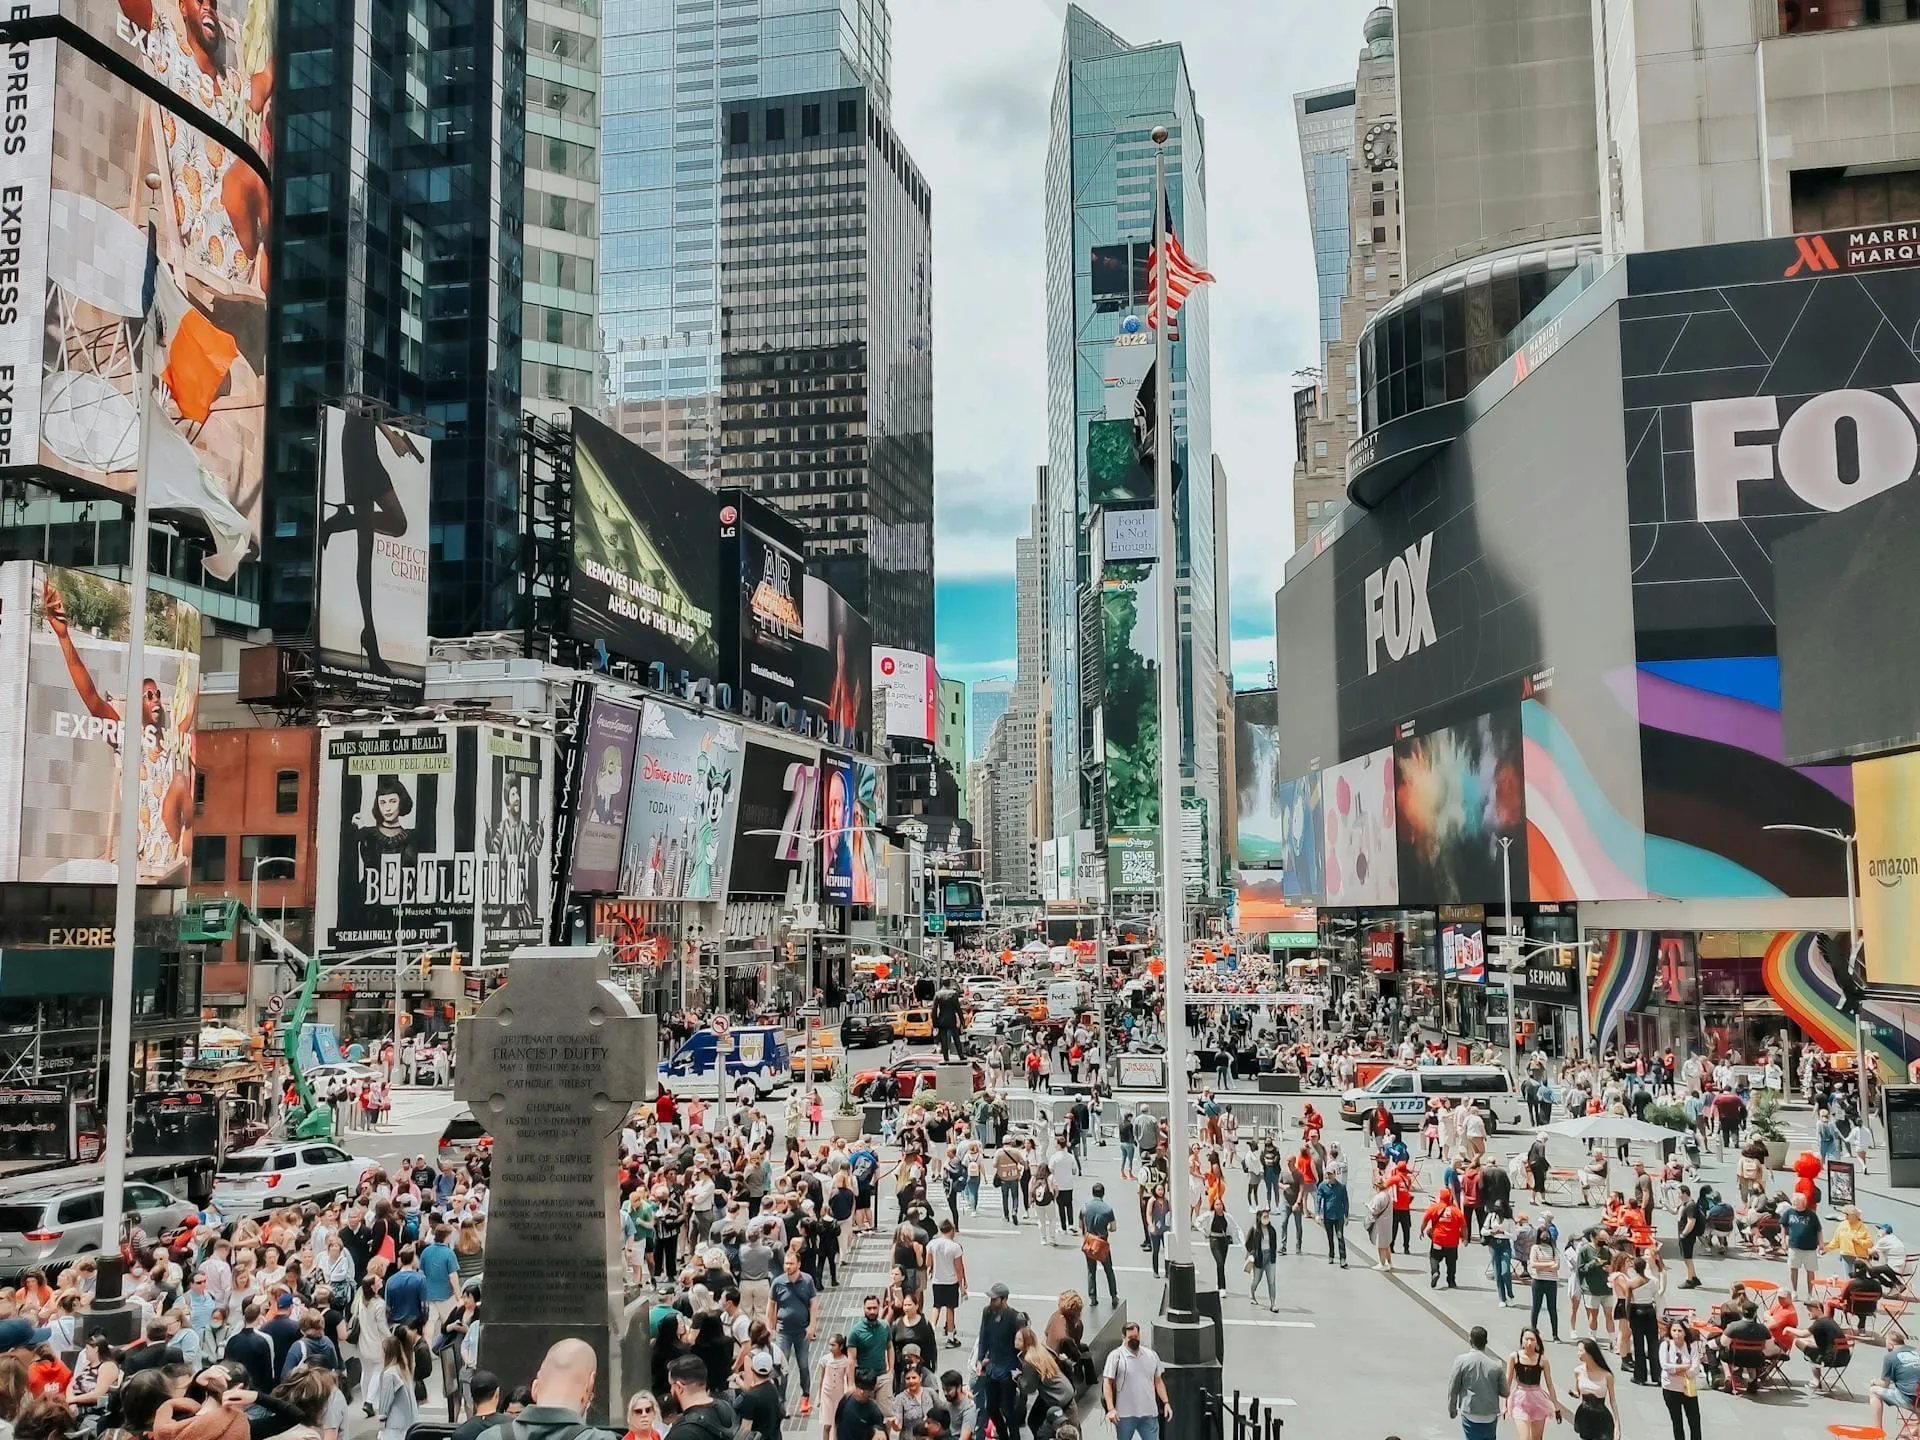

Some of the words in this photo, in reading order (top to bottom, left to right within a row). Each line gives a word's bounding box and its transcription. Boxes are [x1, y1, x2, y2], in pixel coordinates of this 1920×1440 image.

[0, 185, 23, 326] EXPRESS
[1851, 245, 1920, 264] MARQ
[1113, 333, 1148, 347] 2022
[1691, 382, 1920, 522] FO
[1119, 514, 1144, 525] Food
[720, 527, 735, 537] LG
[1116, 529, 1124, 539] Is
[1129, 528, 1148, 538] Not
[376, 539, 427, 565] PERFECT
[391, 561, 427, 583] CRIME
[763, 549, 793, 599] AIR
[585, 559, 628, 593] REMOVES
[629, 578, 661, 607] UNSEEN
[663, 593, 680, 614] DIRT
[1365, 531, 1437, 675] FOX
[608, 594, 638, 620] AHEAD
[640, 607, 651, 625] OF
[652, 611, 666, 633] THE
[667, 617, 695, 643] BLADES
[331, 742, 356, 755] TIMES
[358, 740, 390, 755] SQUARE
[393, 739, 410, 751] CAN
[412, 736, 444, 751] REALLY
[352, 759, 376, 771] MAKE
[379, 758, 396, 770] YOU
[399, 758, 420, 769] FEEL
[672, 770, 692, 786] store
[1869, 857, 1918, 877] amazon
[50, 928, 117, 946] EXPRE
[1529, 969, 1567, 987] SEPHORA
[40, 1057, 74, 1068] EXPRESS
[493, 1047, 547, 1060] FRANCIS
[564, 1047, 608, 1060] DUFFY
[1389, 1101, 1424, 1110] NYPD
[554, 1154, 592, 1164] SERVICE
[502, 1173, 523, 1183] GOD
[549, 1173, 594, 1183] COUNTRY
